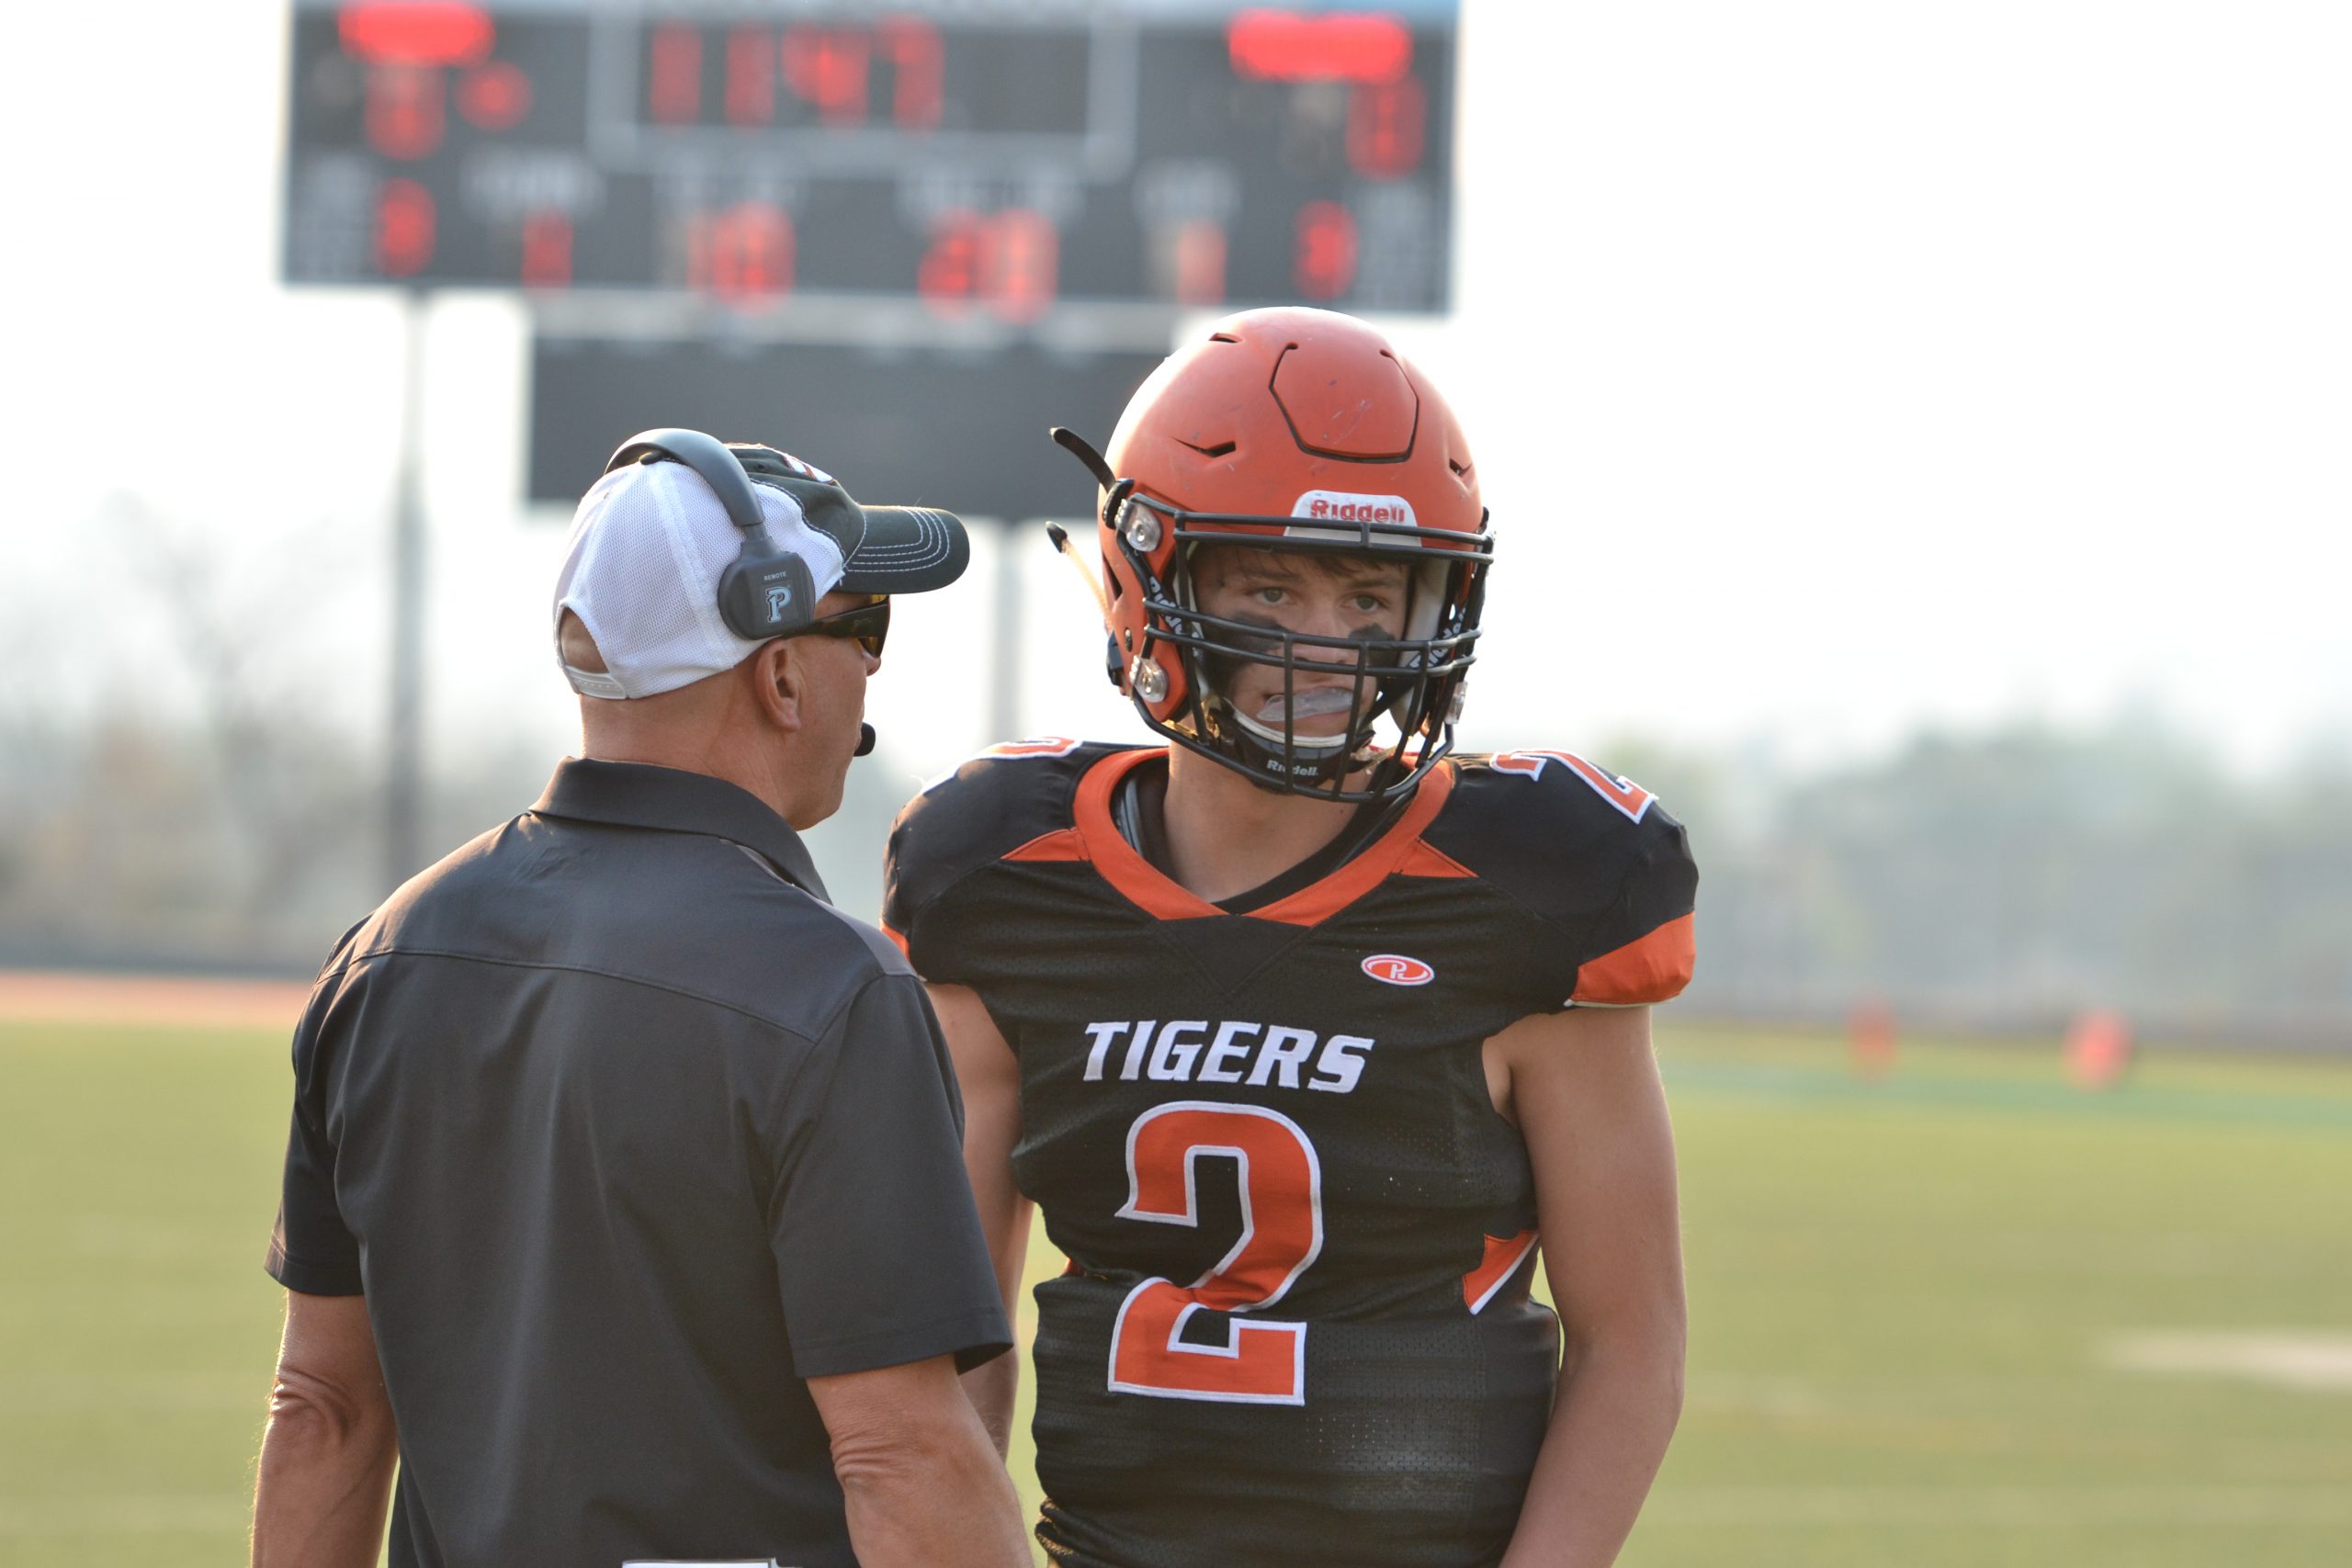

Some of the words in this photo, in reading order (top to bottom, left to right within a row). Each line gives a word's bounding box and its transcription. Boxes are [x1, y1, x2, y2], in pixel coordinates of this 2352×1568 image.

[1310, 499, 1405, 523] Riddell
[763, 570, 787, 581] REMOTE
[1267, 759, 1318, 776] Ridell
[1083, 1020, 1375, 1093] TIGERS
[1108, 1100, 1324, 1406] 2
